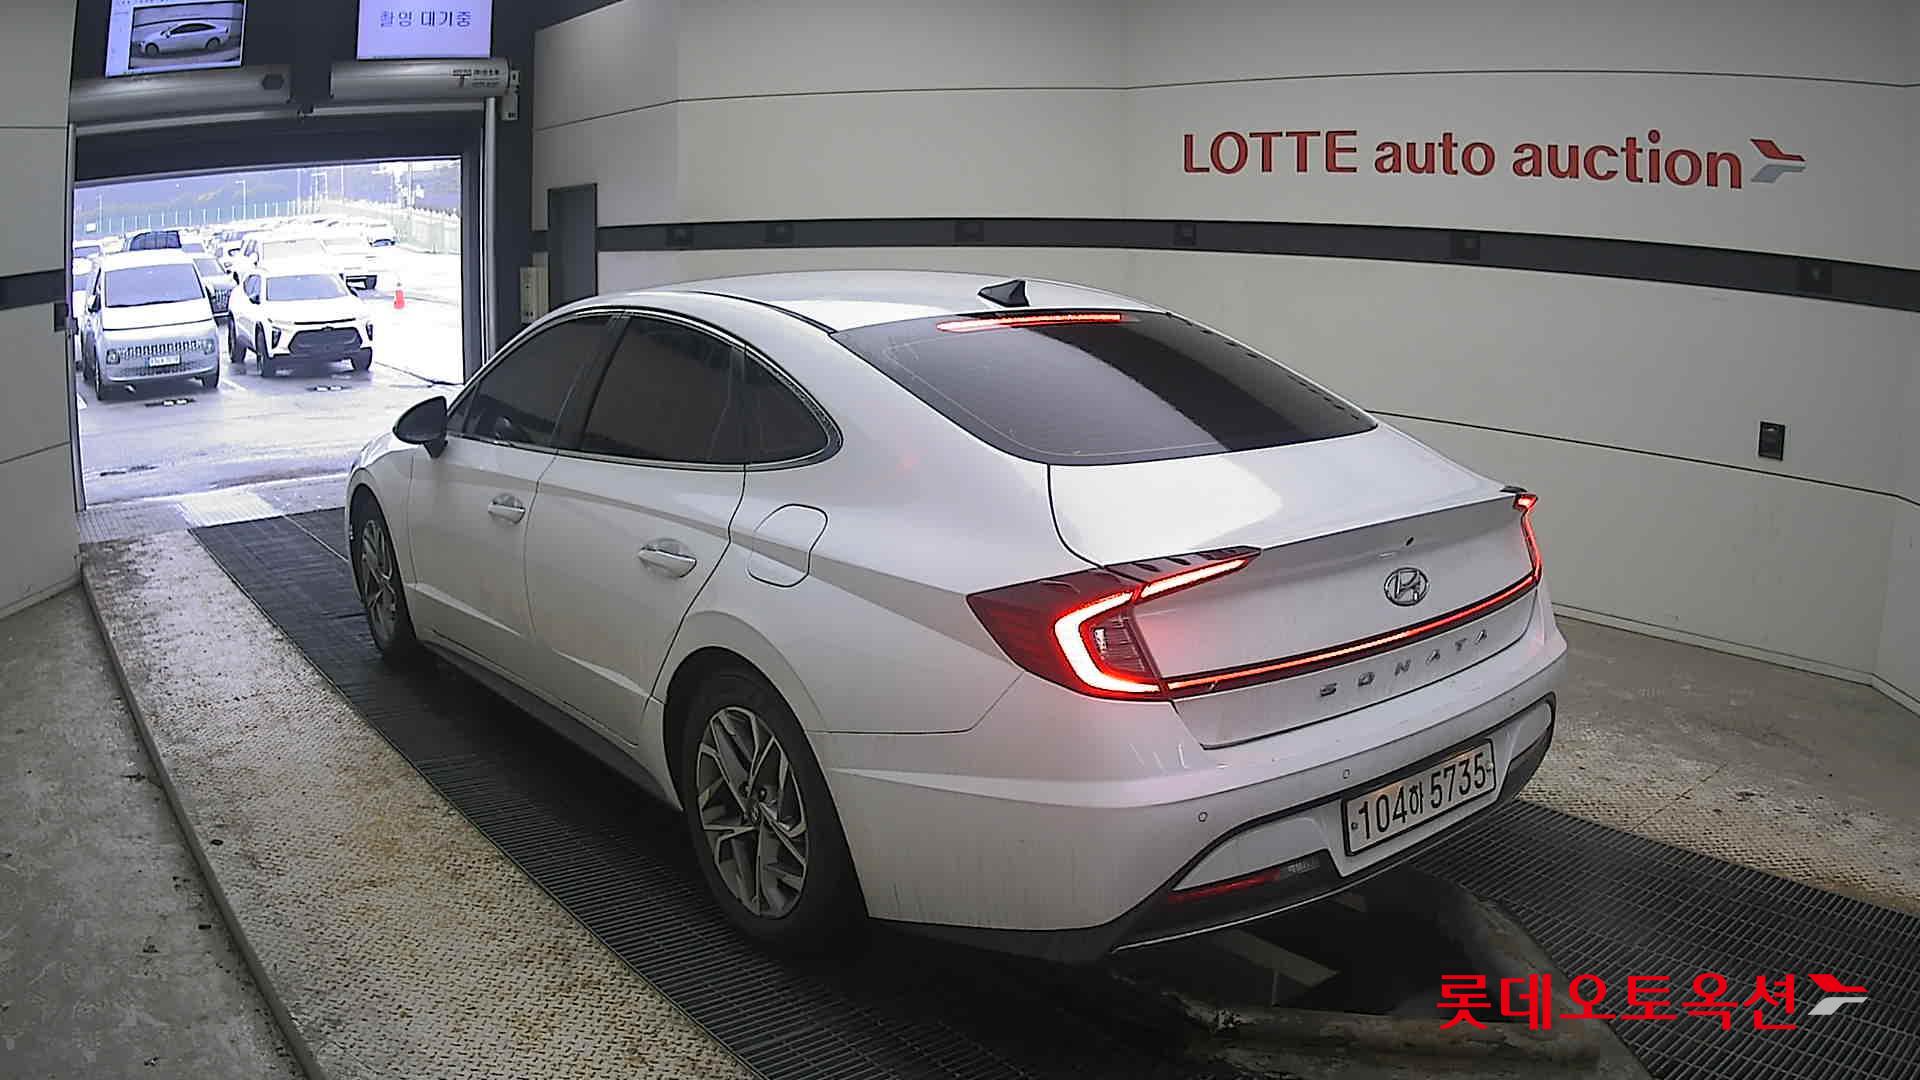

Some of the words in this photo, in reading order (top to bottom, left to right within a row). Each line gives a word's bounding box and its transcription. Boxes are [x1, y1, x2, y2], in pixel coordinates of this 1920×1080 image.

[420, 10, 471, 27] 대기중
[1183, 130, 1358, 175] LOTTE
[1374, 132, 1496, 176] auto
[1512, 129, 1743, 190] auction
[1319, 629, 1488, 698] SONATA
[1358, 781, 1424, 840] 104하
[1430, 751, 1487, 809] 5735
